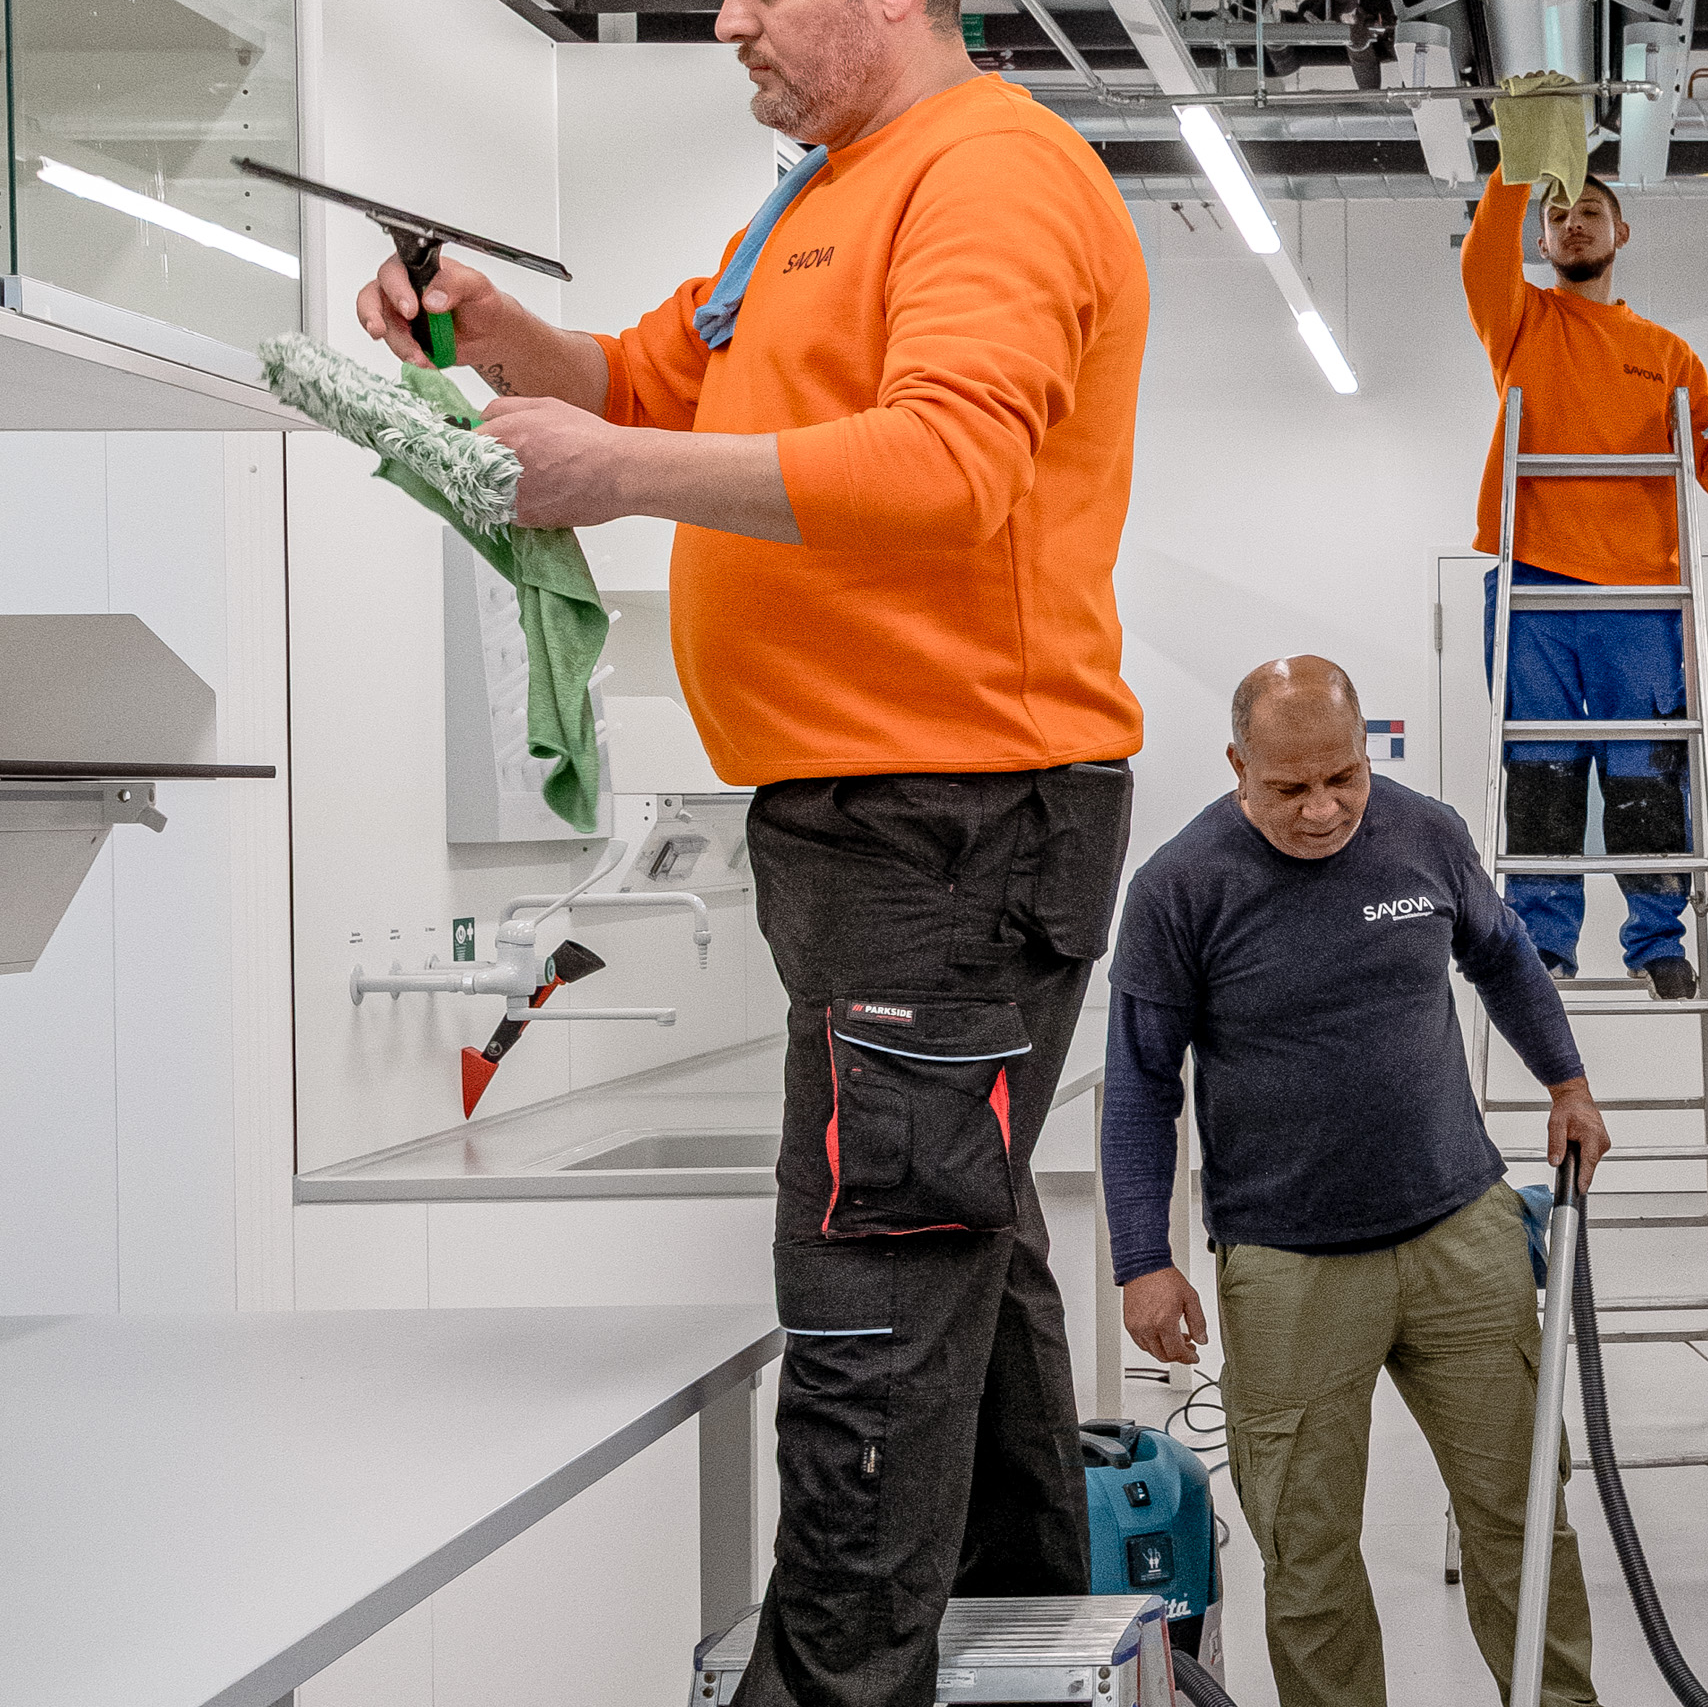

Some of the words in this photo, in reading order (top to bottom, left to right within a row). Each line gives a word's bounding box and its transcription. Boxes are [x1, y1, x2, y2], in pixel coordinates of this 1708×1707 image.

[782, 245, 835, 275] SAVOVA
[1622, 363, 1665, 384] SAVOVA
[1362, 896, 1436, 922] SAVOVA
[864, 1005, 914, 1019] PARKSIDE
